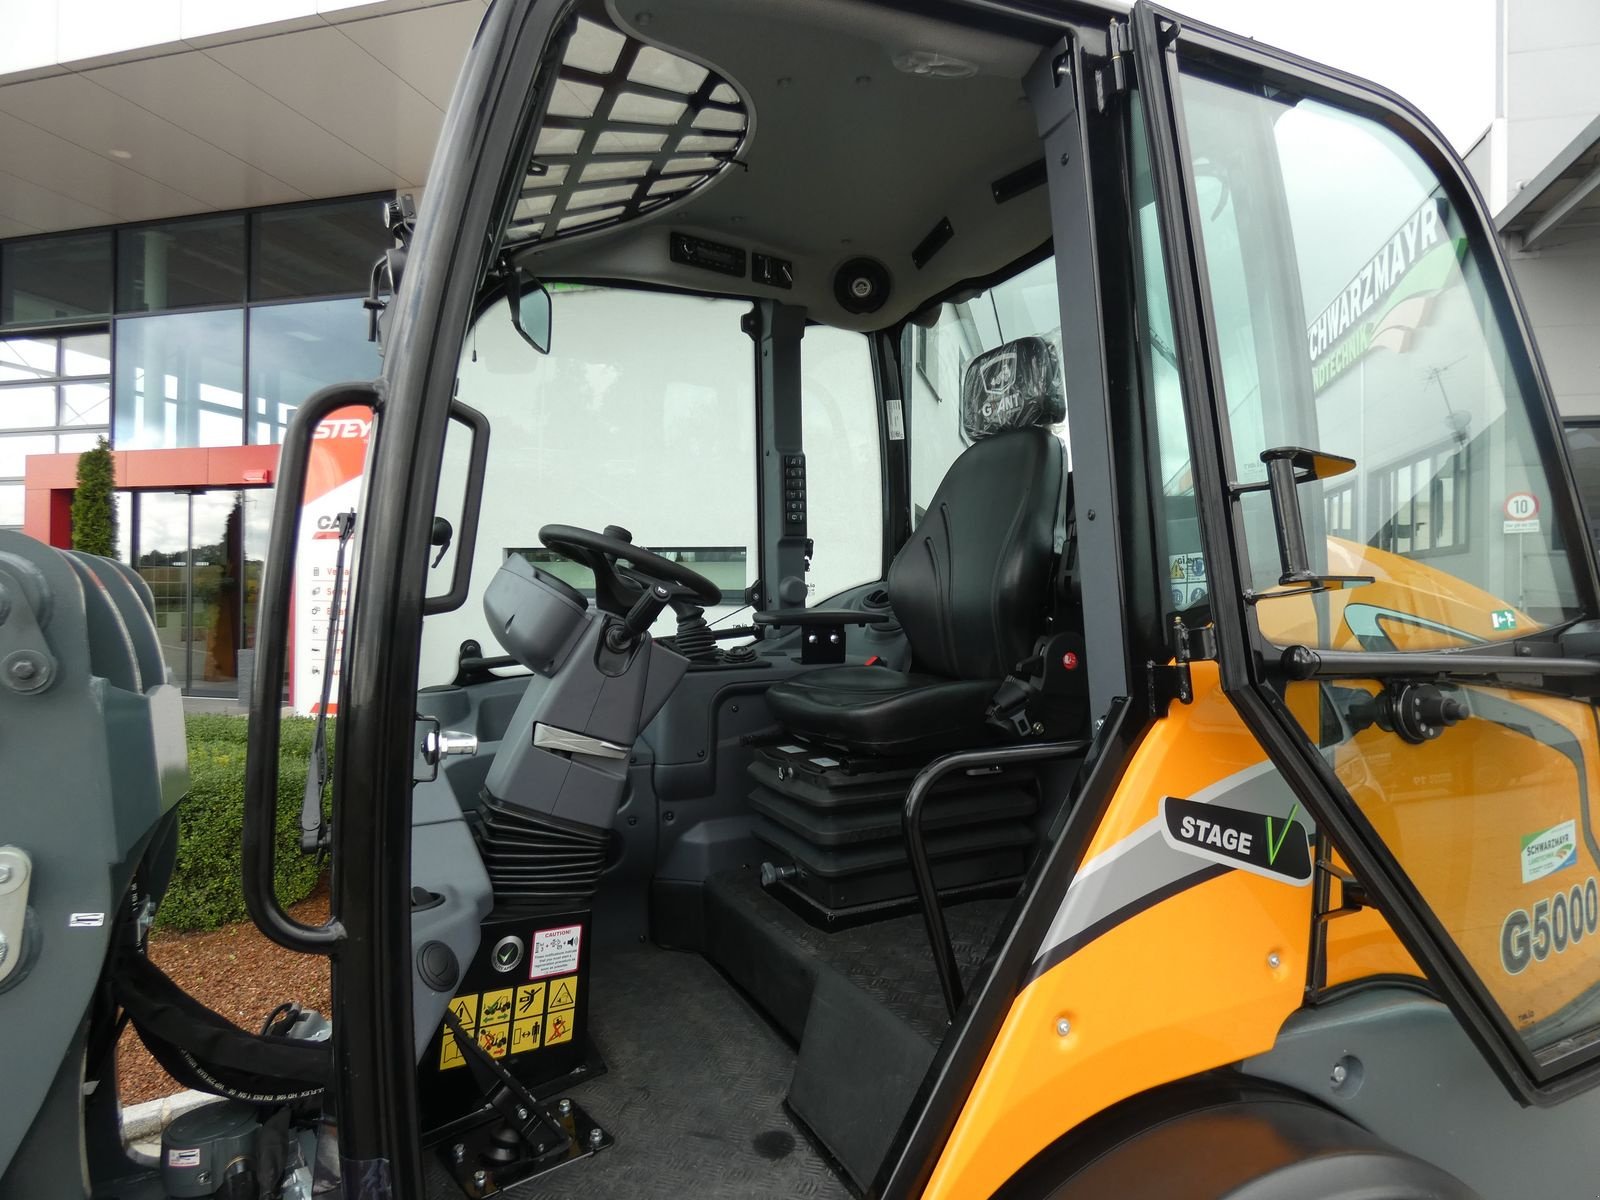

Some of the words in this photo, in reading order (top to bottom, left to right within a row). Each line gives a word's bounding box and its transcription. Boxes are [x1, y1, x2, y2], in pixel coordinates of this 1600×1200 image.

[1308, 197, 1437, 361] CHWARZMAYR
[1514, 500, 1528, 514] 10
[1180, 815, 1253, 855] STAGE
[1265, 804, 1299, 866] V
[1527, 833, 1569, 856] SCHWARZMAYR
[1500, 876, 1599, 975] G5000
